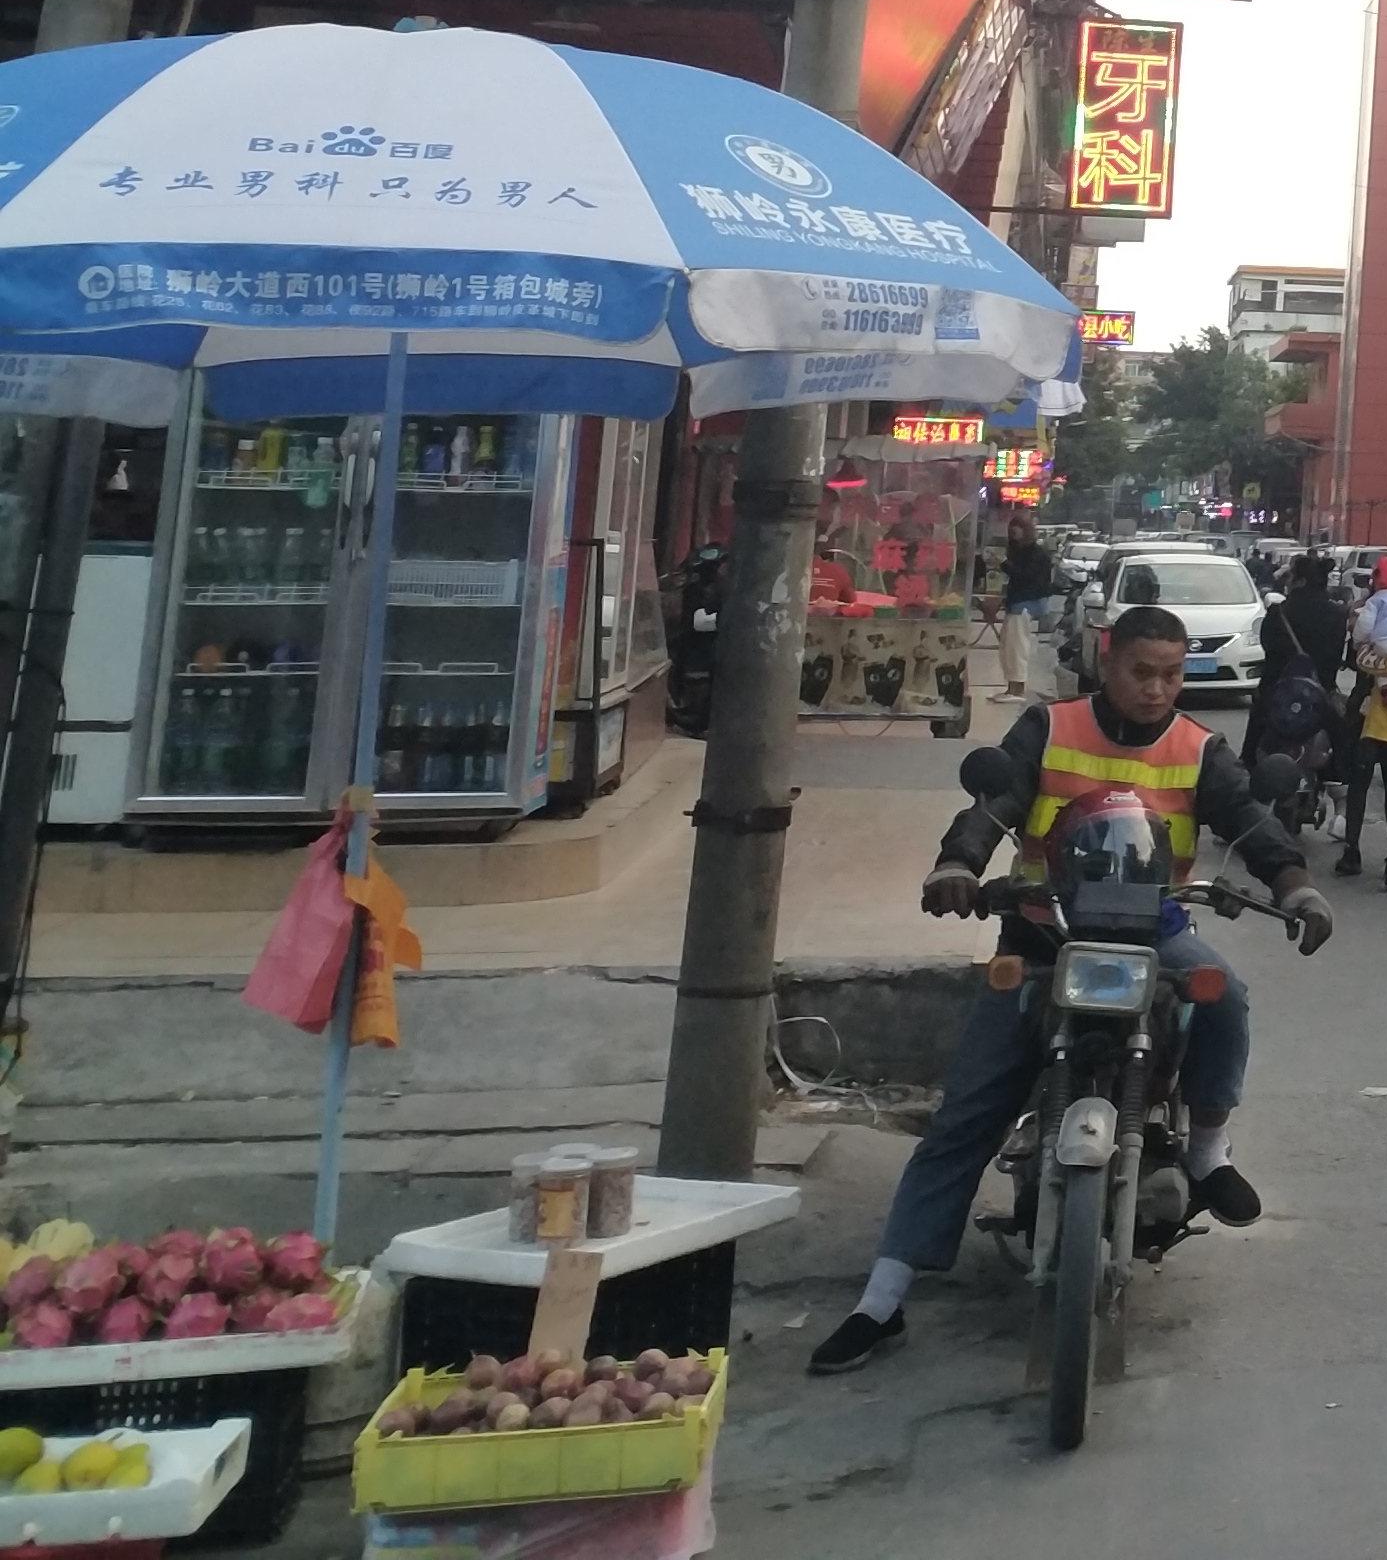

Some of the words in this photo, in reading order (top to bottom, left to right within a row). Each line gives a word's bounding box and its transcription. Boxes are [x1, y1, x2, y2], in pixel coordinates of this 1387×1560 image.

[389, 141, 455, 160] 百度
[1081, 51, 1168, 204] 牙科
[680, 183, 974, 255] 狮岭永康医疗
[711, 221, 795, 244] SHILING
[798, 232, 908, 259] YONGKANG
[909, 247, 1004, 274] HOSPITAL
[846, 281, 928, 308] 28616699
